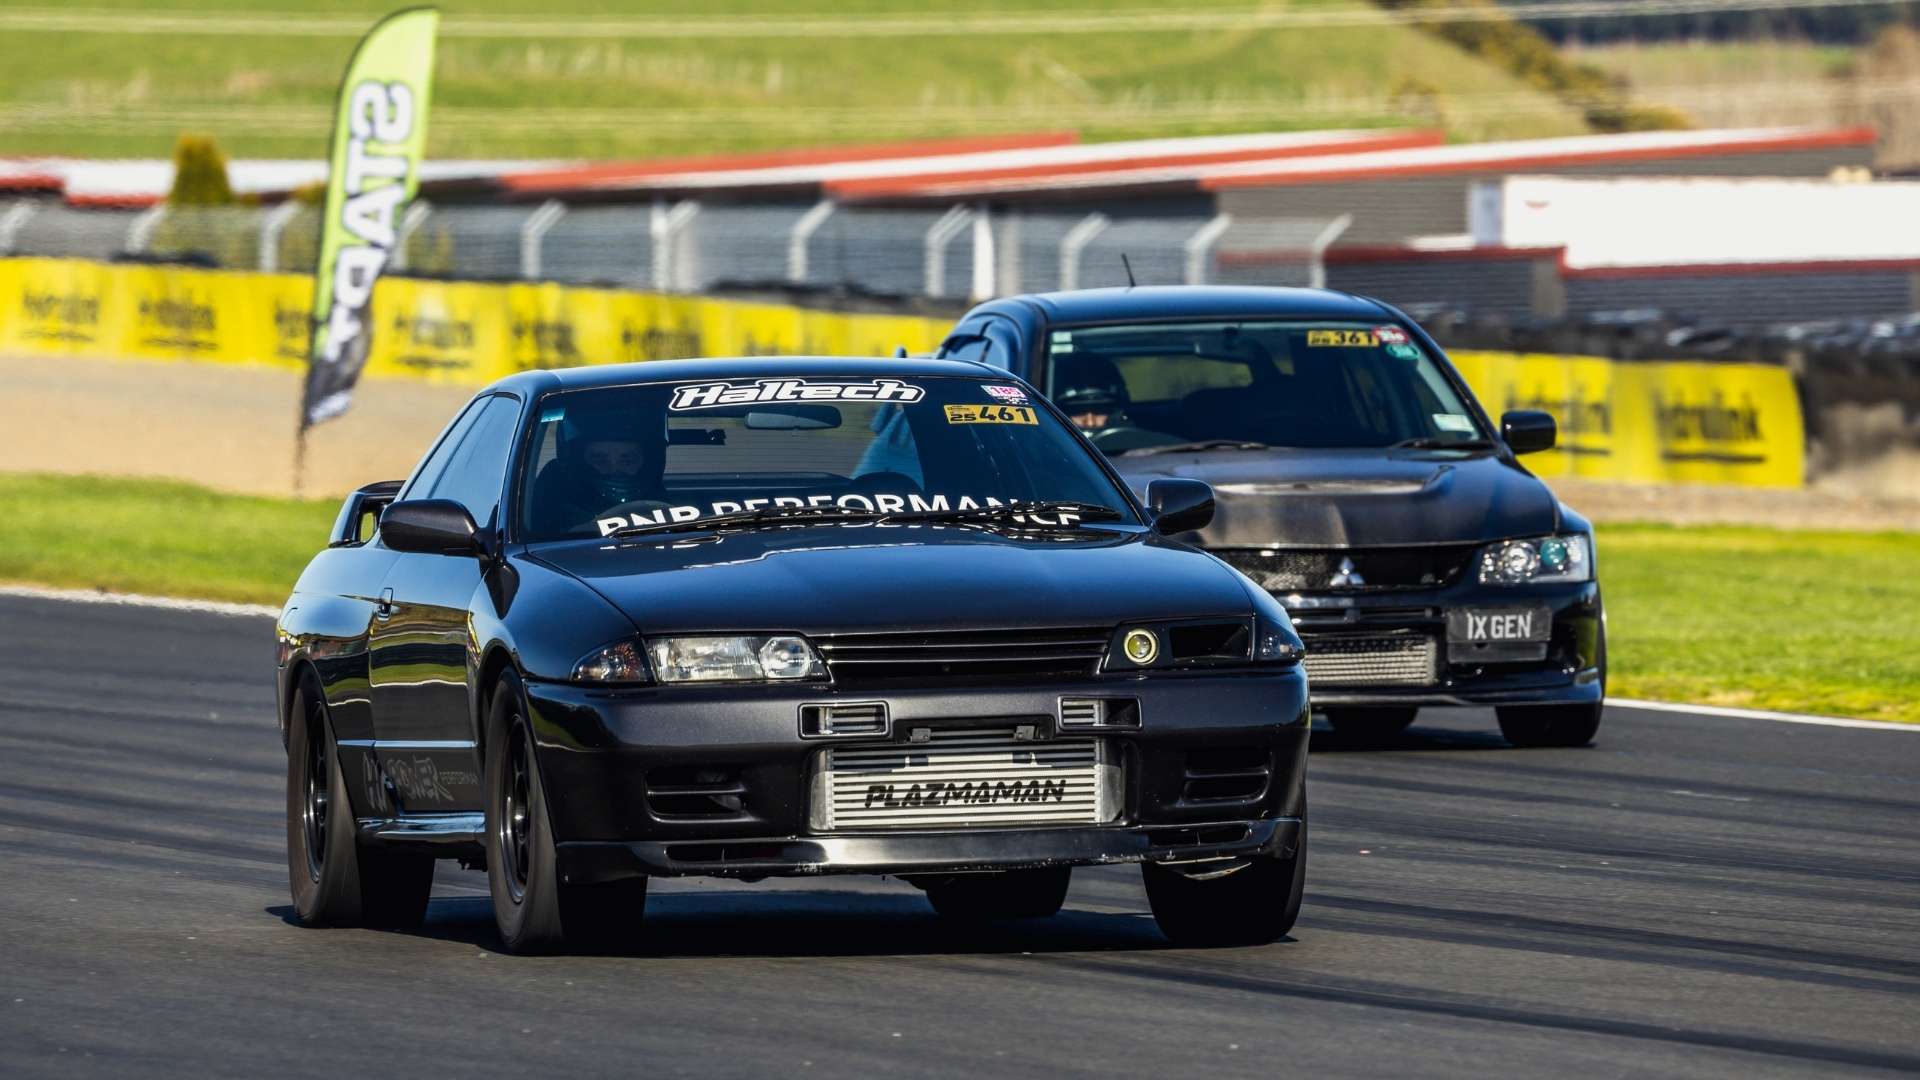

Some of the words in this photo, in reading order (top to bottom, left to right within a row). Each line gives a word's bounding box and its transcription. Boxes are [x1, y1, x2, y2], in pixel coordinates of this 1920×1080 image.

[669, 379, 926, 411] Haltech
[950, 413, 977, 422] 25
[979, 406, 1031, 422] 461
[864, 779, 1067, 808] PLAZMAMAN
